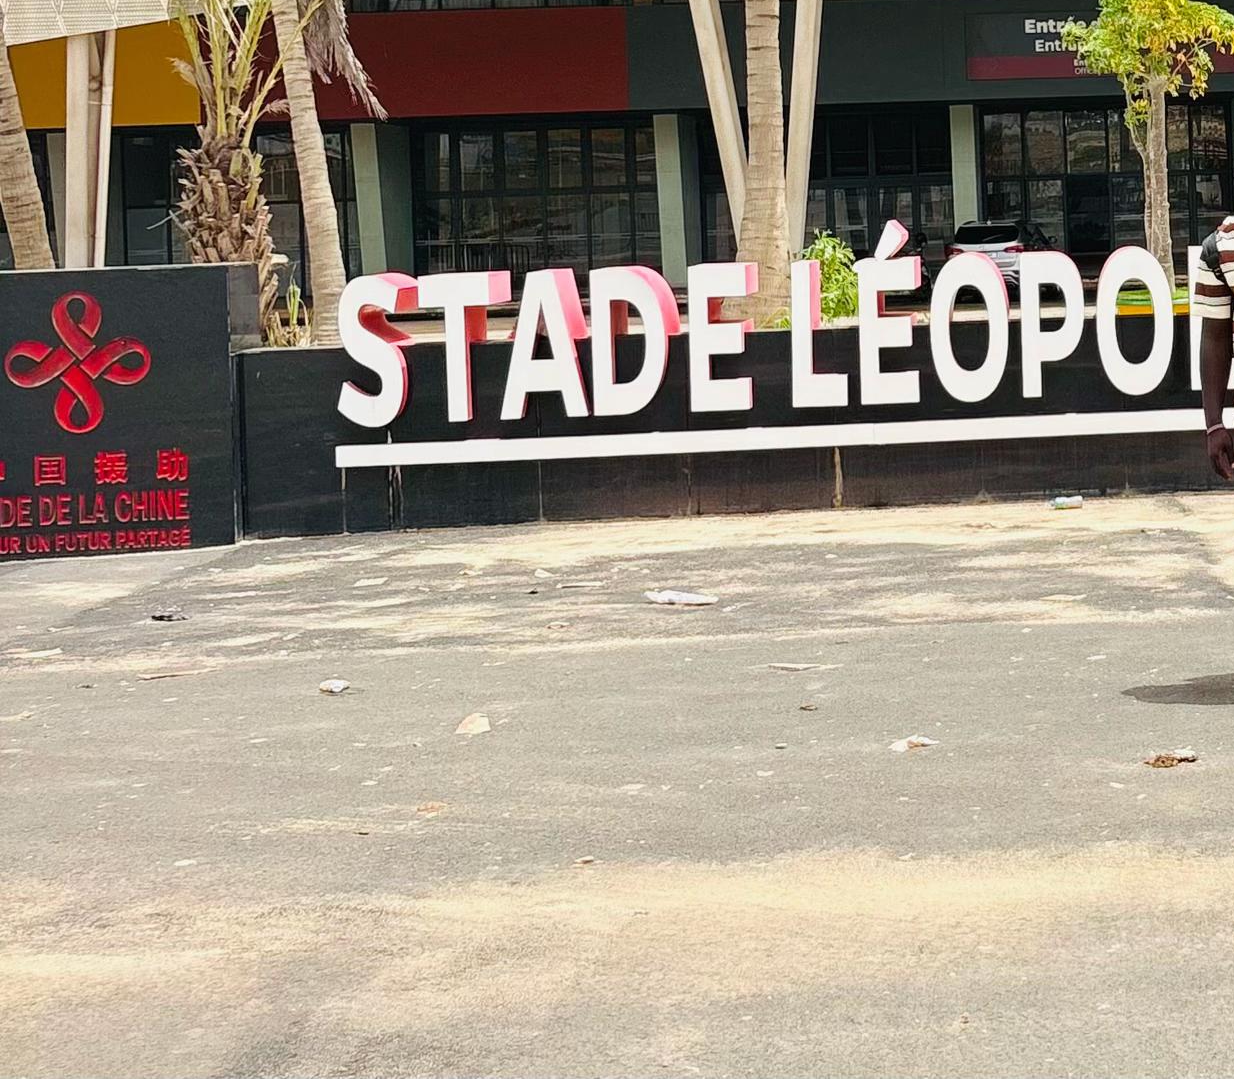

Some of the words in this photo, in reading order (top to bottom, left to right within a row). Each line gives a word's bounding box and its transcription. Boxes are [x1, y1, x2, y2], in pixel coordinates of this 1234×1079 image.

[337, 262, 756, 428] STADE
[0, 448, 190, 486] 国援助
[39, 493, 73, 526] DE
[78, 490, 109, 525] LA
[114, 488, 191, 523] CHINE
[25, 533, 50, 553] UN
[55, 529, 112, 552] FUTUR
[115, 525, 192, 550] PARTAGÉ
